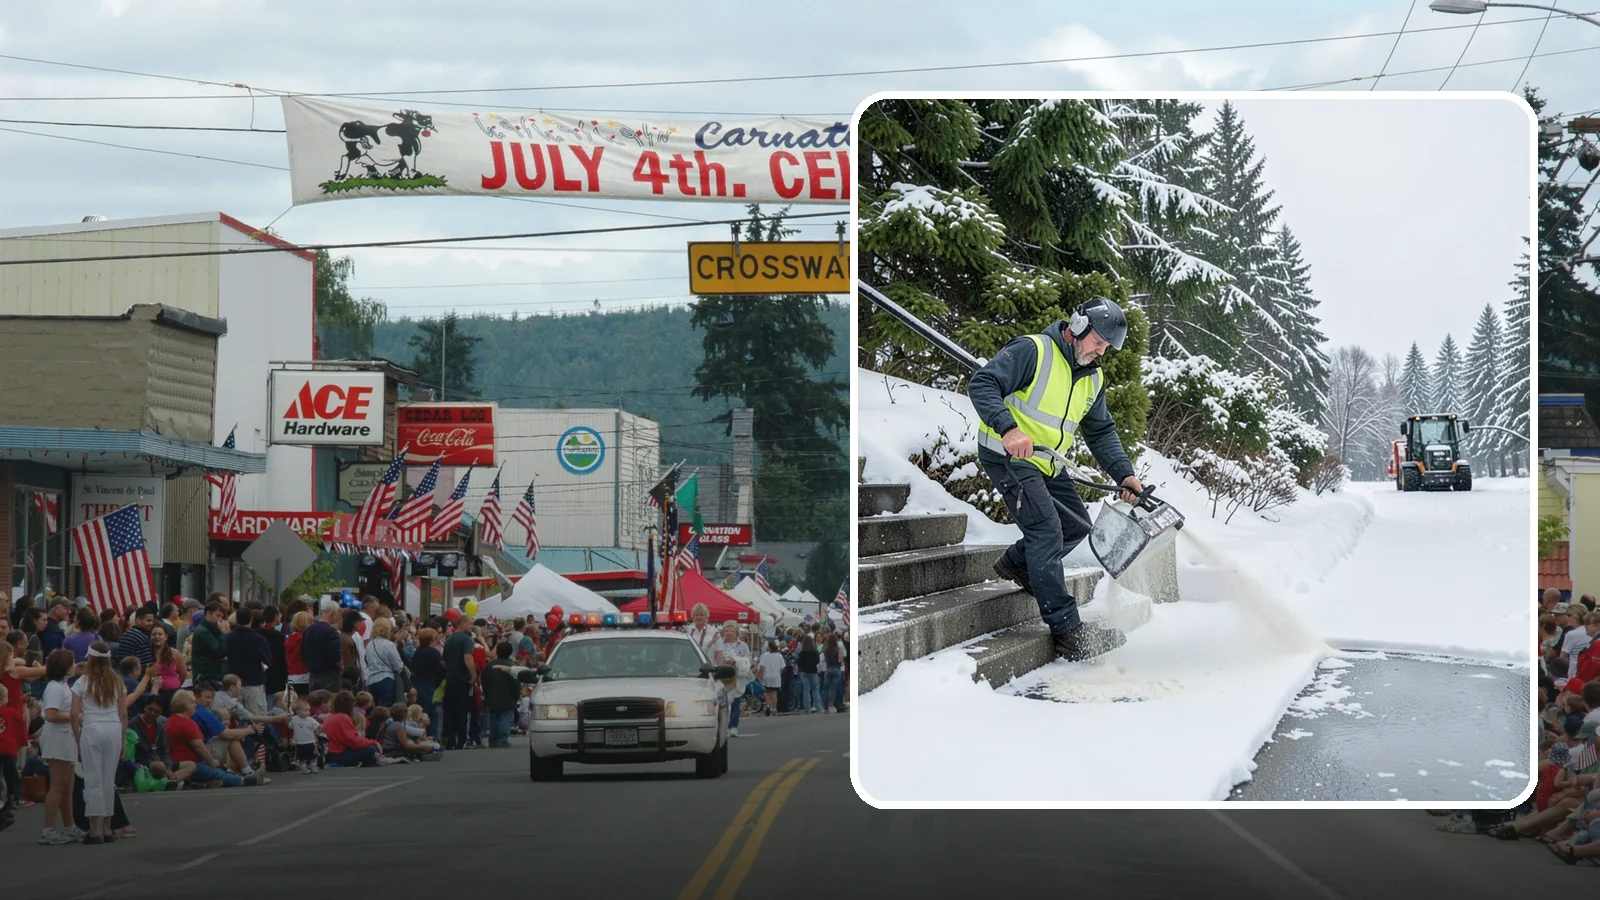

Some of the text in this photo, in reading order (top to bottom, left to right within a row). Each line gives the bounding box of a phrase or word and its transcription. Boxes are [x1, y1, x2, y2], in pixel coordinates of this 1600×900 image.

[695, 121, 850, 149] Carnat
[481, 141, 605, 192] JULY
[632, 150, 746, 197] 4th.
[697, 254, 850, 279] CROSSWA
[282, 380, 373, 420] ACE
[405, 409, 452, 421] CEDAR
[283, 421, 371, 436] Hardware
[416, 428, 476, 447] Coca-Cola
[354, 467, 387, 480] Simpl
[96, 485, 124, 495] Vincent
[126, 486, 136, 495] de
[138, 486, 155, 495] Paul
[81, 503, 153, 522] THT
[688, 527, 741, 535] CRNATION
[699, 535, 730, 543] GLASS
